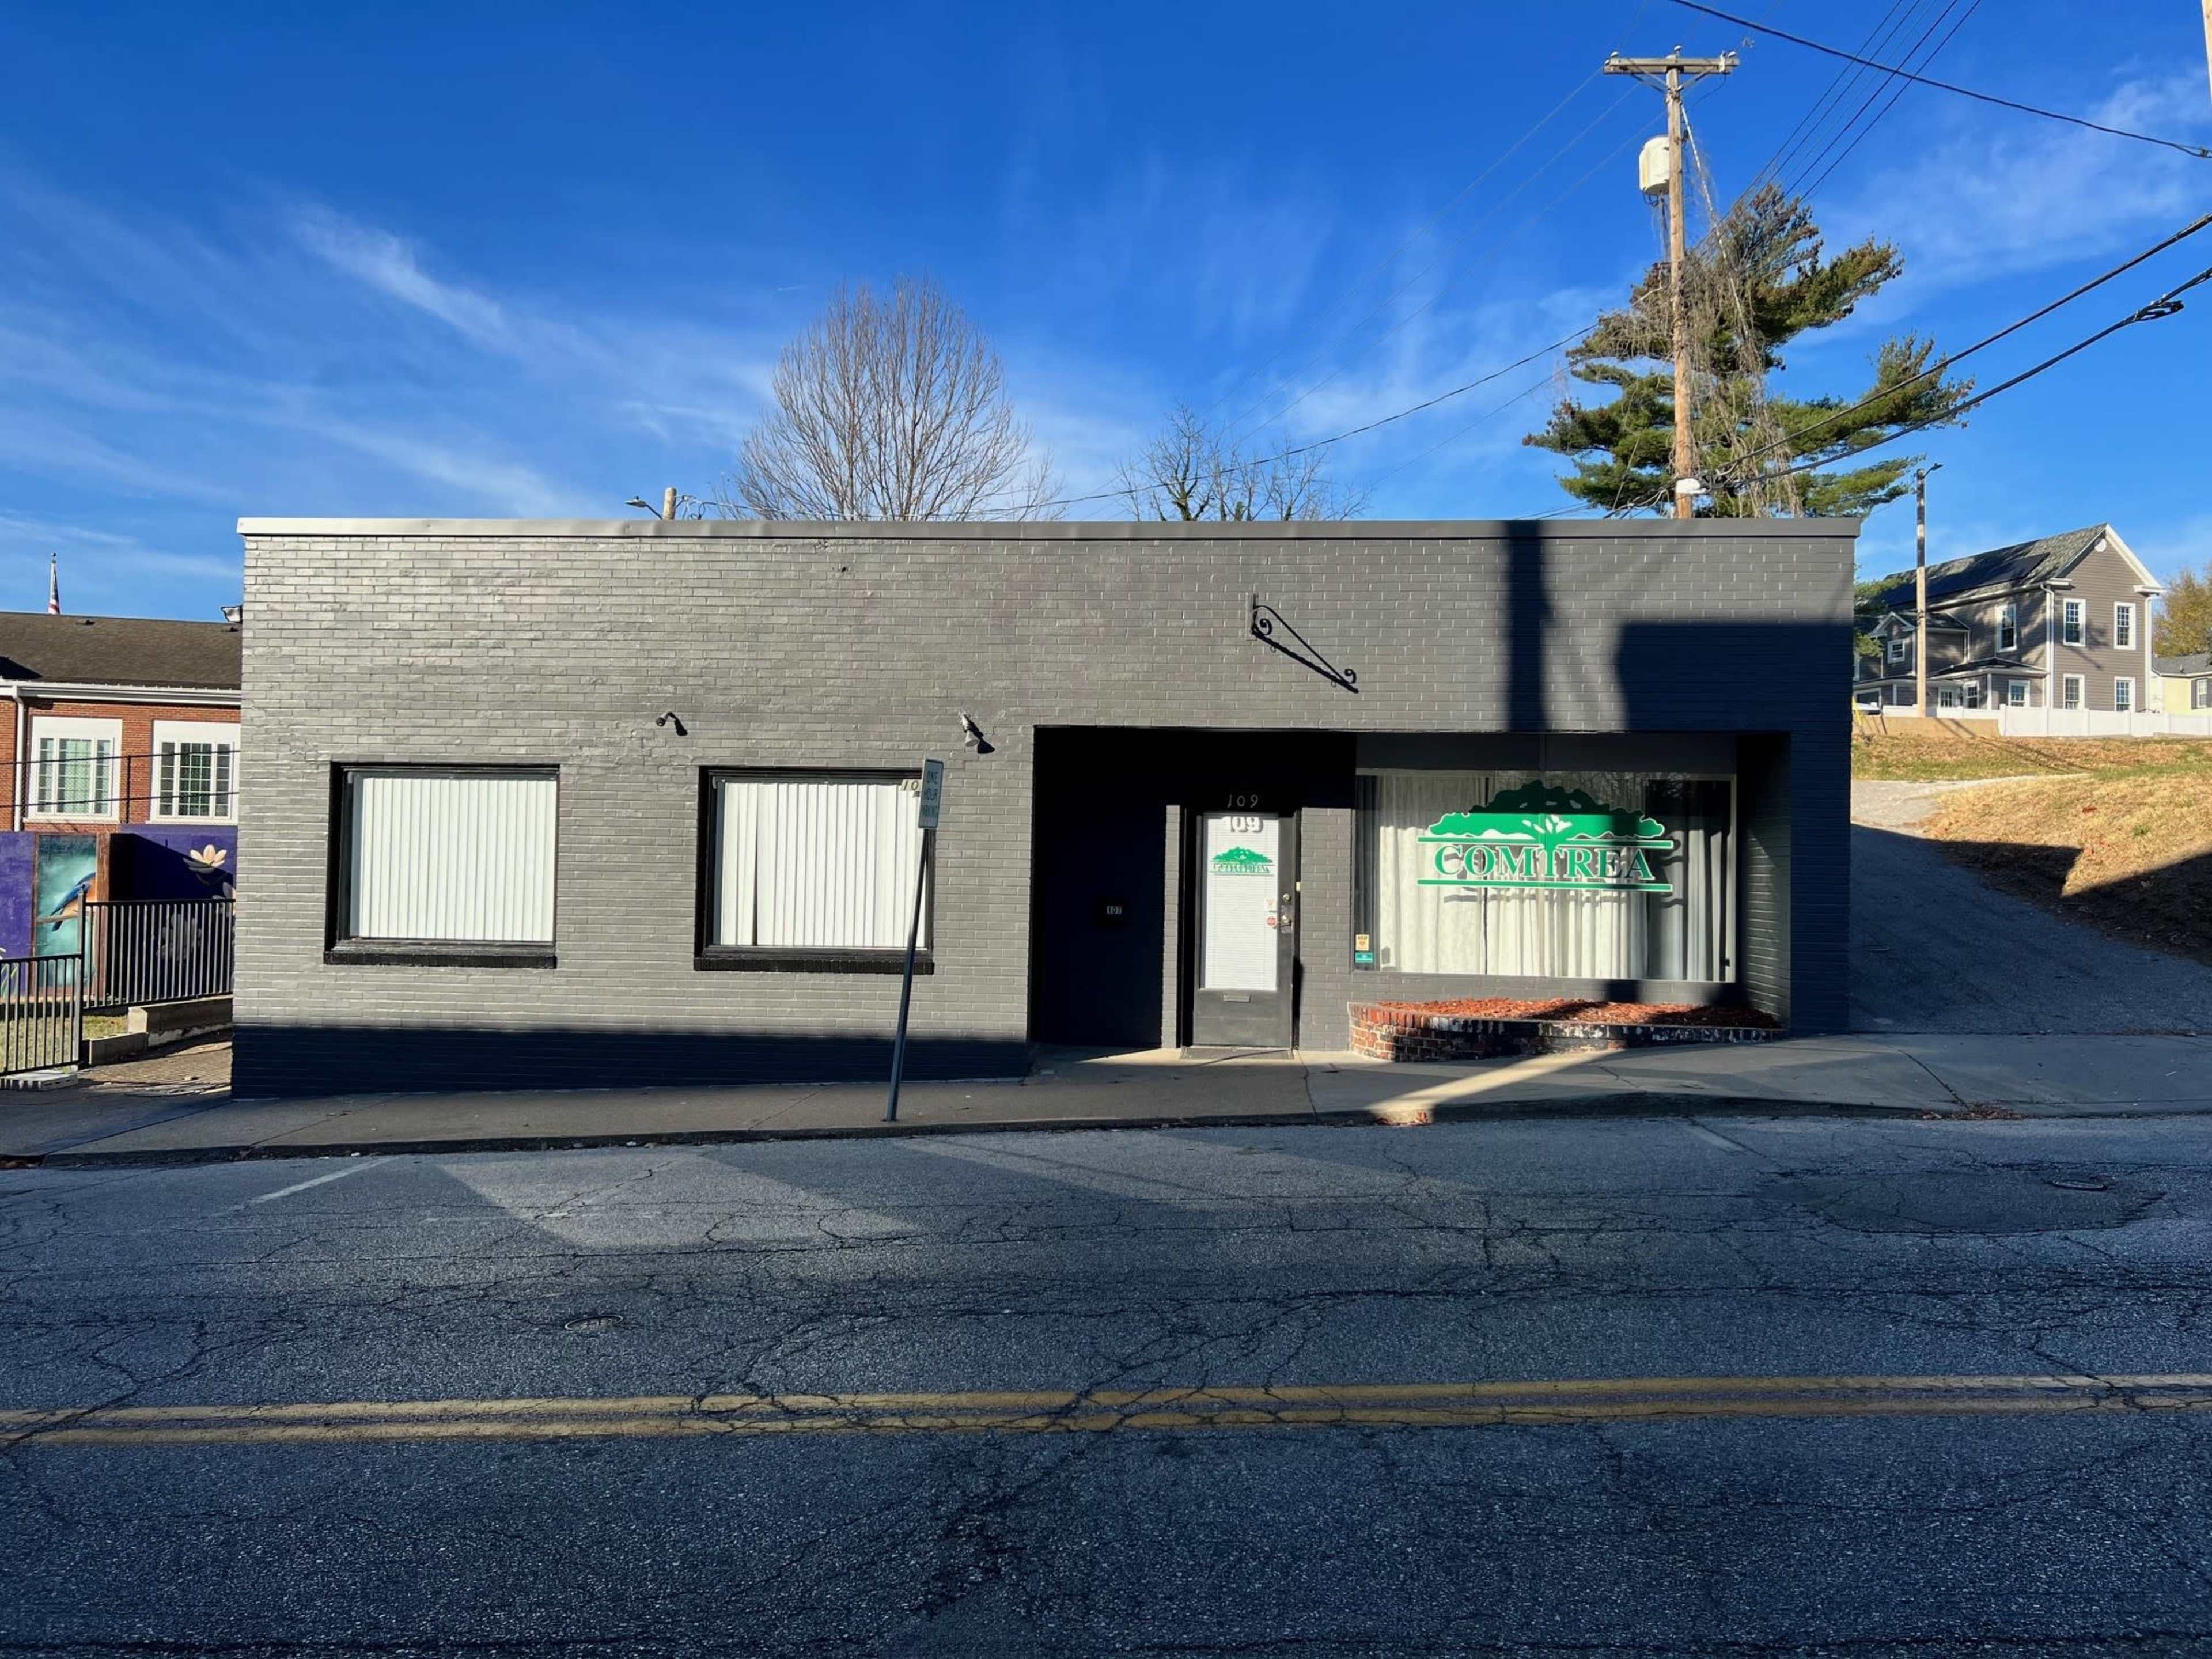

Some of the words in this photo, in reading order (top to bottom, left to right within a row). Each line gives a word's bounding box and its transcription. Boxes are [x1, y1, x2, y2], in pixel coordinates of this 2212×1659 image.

[926, 771, 939, 784] ONE
[923, 787, 938, 801] HOUR
[1228, 794, 1259, 808] 109
[1222, 816, 1263, 833] 109
[1434, 844, 1656, 881] COMTREA
